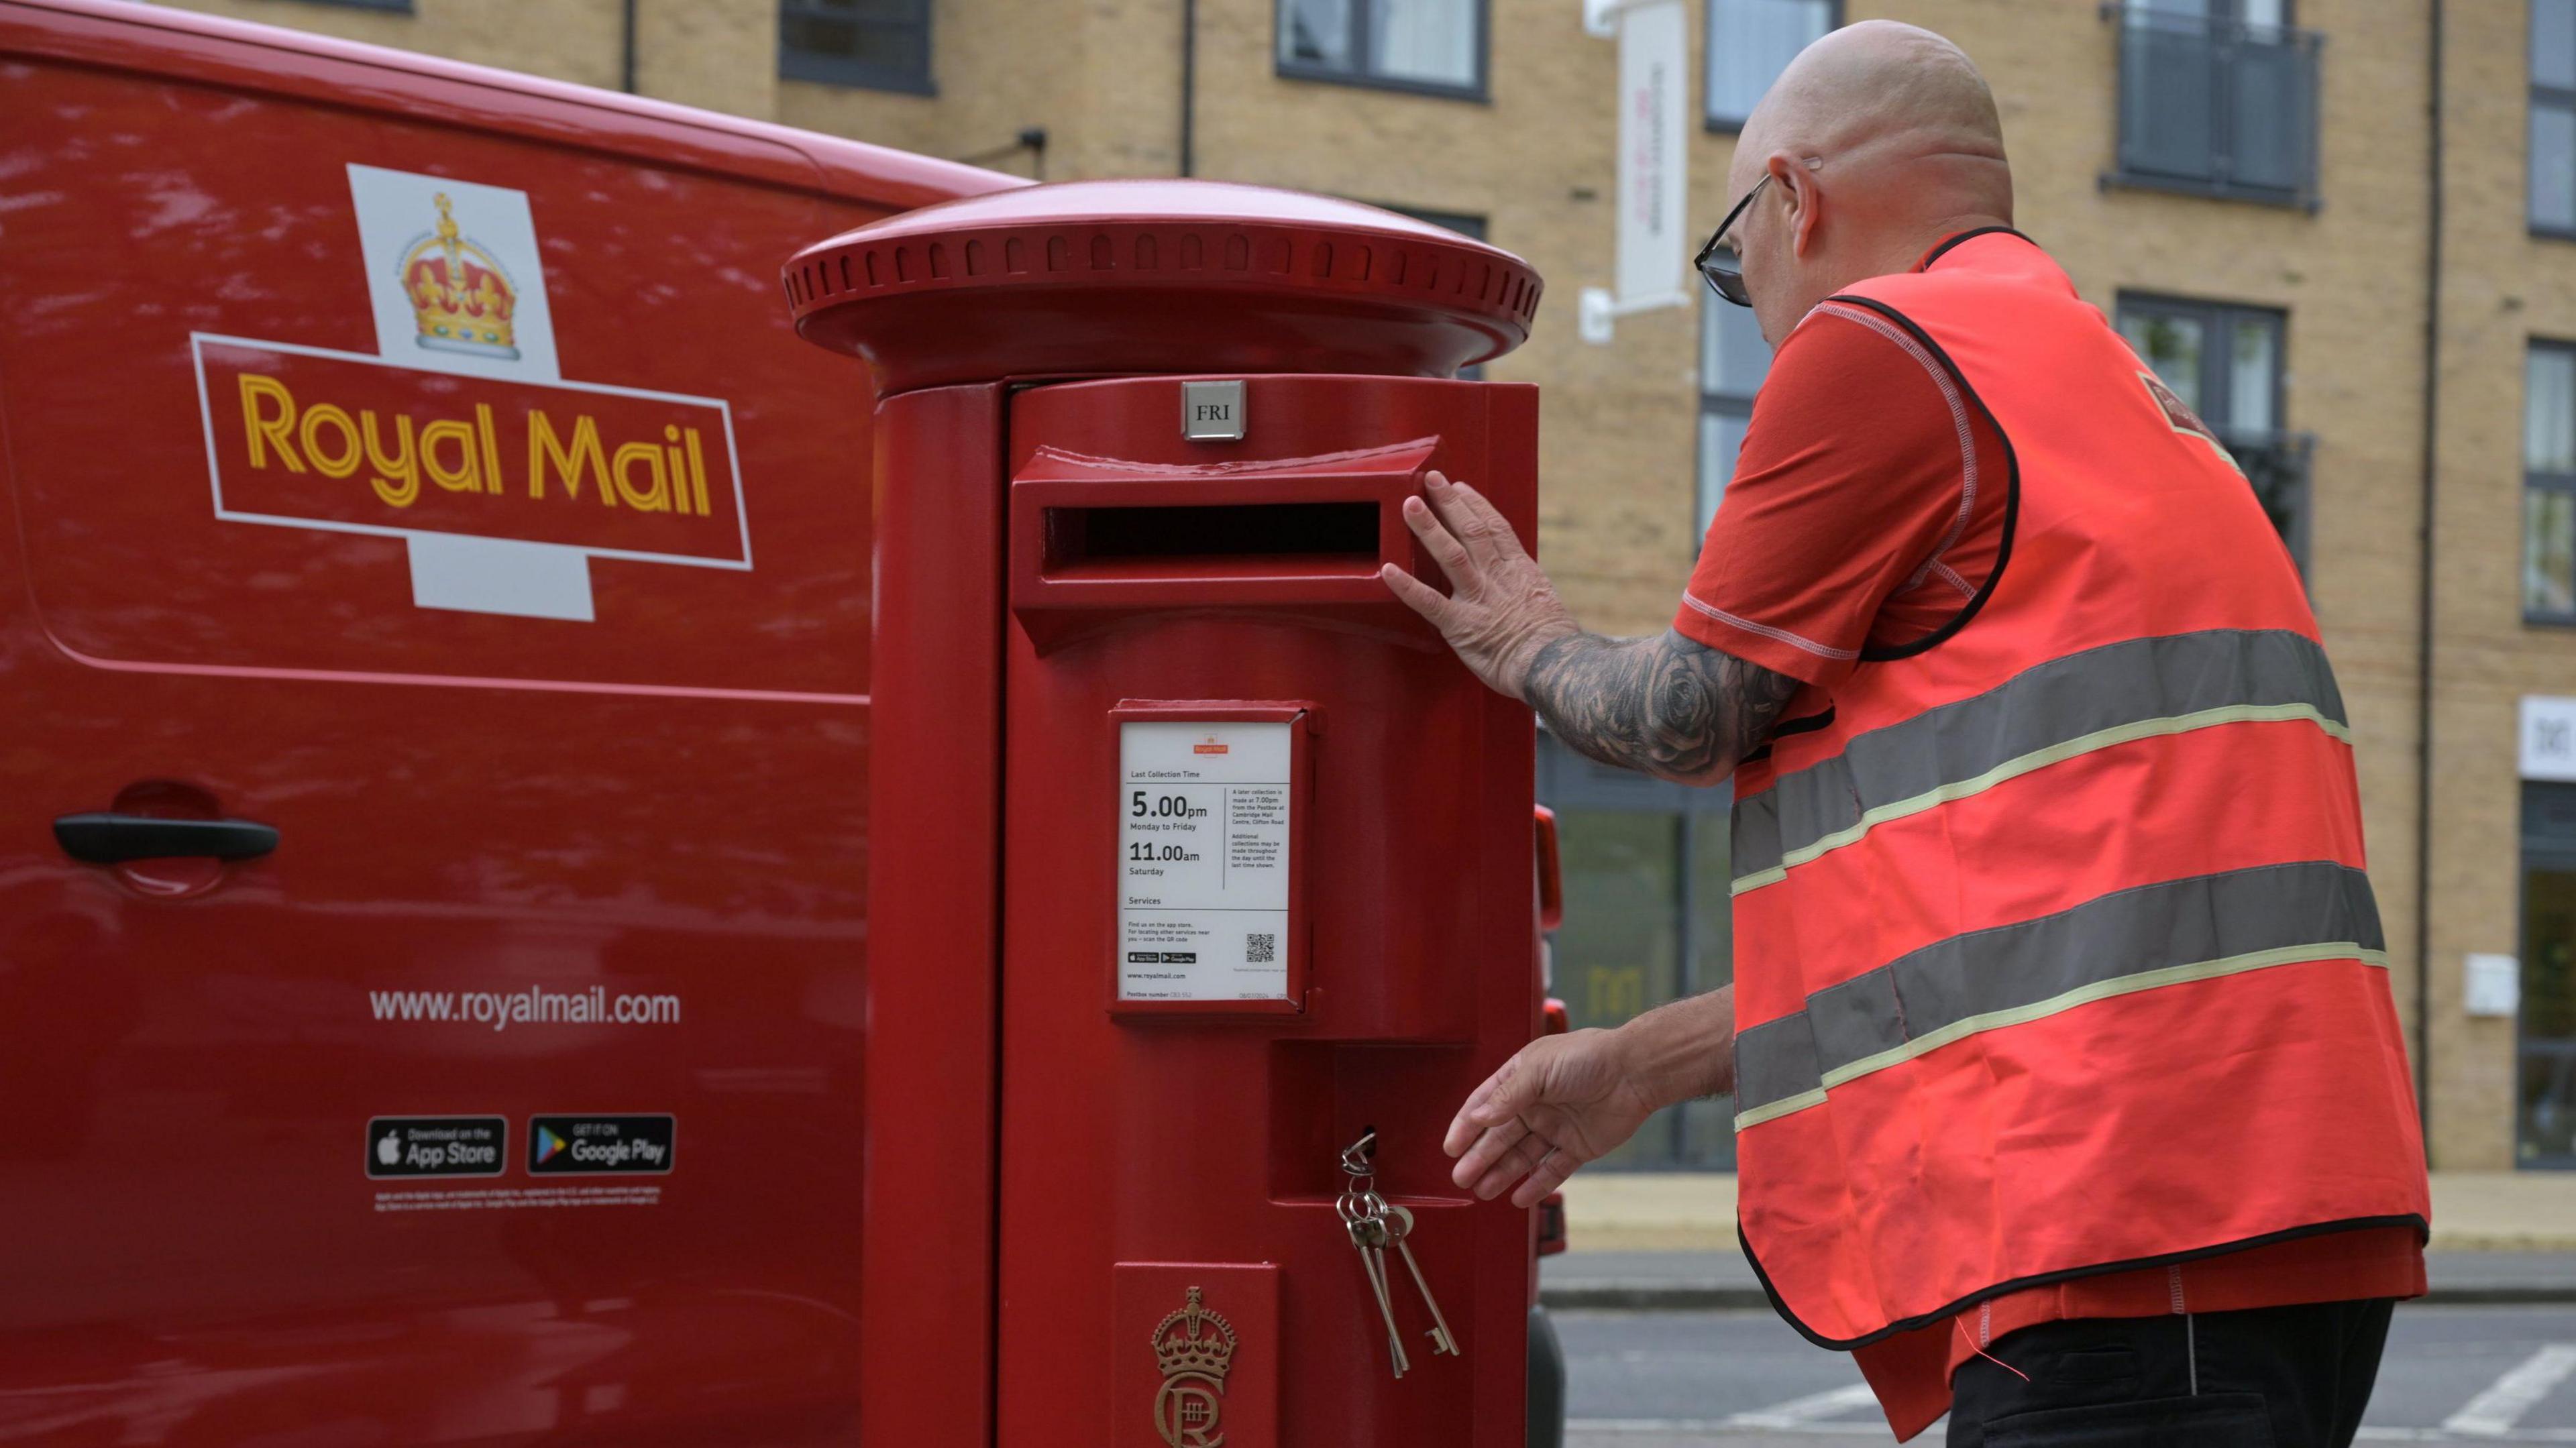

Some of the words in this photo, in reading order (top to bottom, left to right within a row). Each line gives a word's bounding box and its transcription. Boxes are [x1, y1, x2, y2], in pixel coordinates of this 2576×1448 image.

[1196, 404, 1230, 421] FRI
[238, 373, 503, 508] Royal
[529, 409, 710, 516] Mail
[1132, 791, 1207, 819] 5.00pm
[1130, 823, 1160, 832] Monday
[1173, 823, 1197, 832] Friday
[1130, 842, 1199, 861] 11.00am
[1129, 867, 1164, 877] Saturday
[1129, 897, 1161, 905] Services
[370, 985, 680, 1032] www.royalmail.com
[408, 1128, 458, 1140] Download
[459, 1130, 472, 1139] on
[474, 1128, 491, 1139] the
[573, 1124, 591, 1136] GET
[592, 1124, 601, 1135] IT
[602, 1124, 619, 1136] ON
[405, 1142, 445, 1169] App
[447, 1141, 496, 1164] Store
[572, 1138, 631, 1166] Google
[632, 1138, 665, 1166] Play
